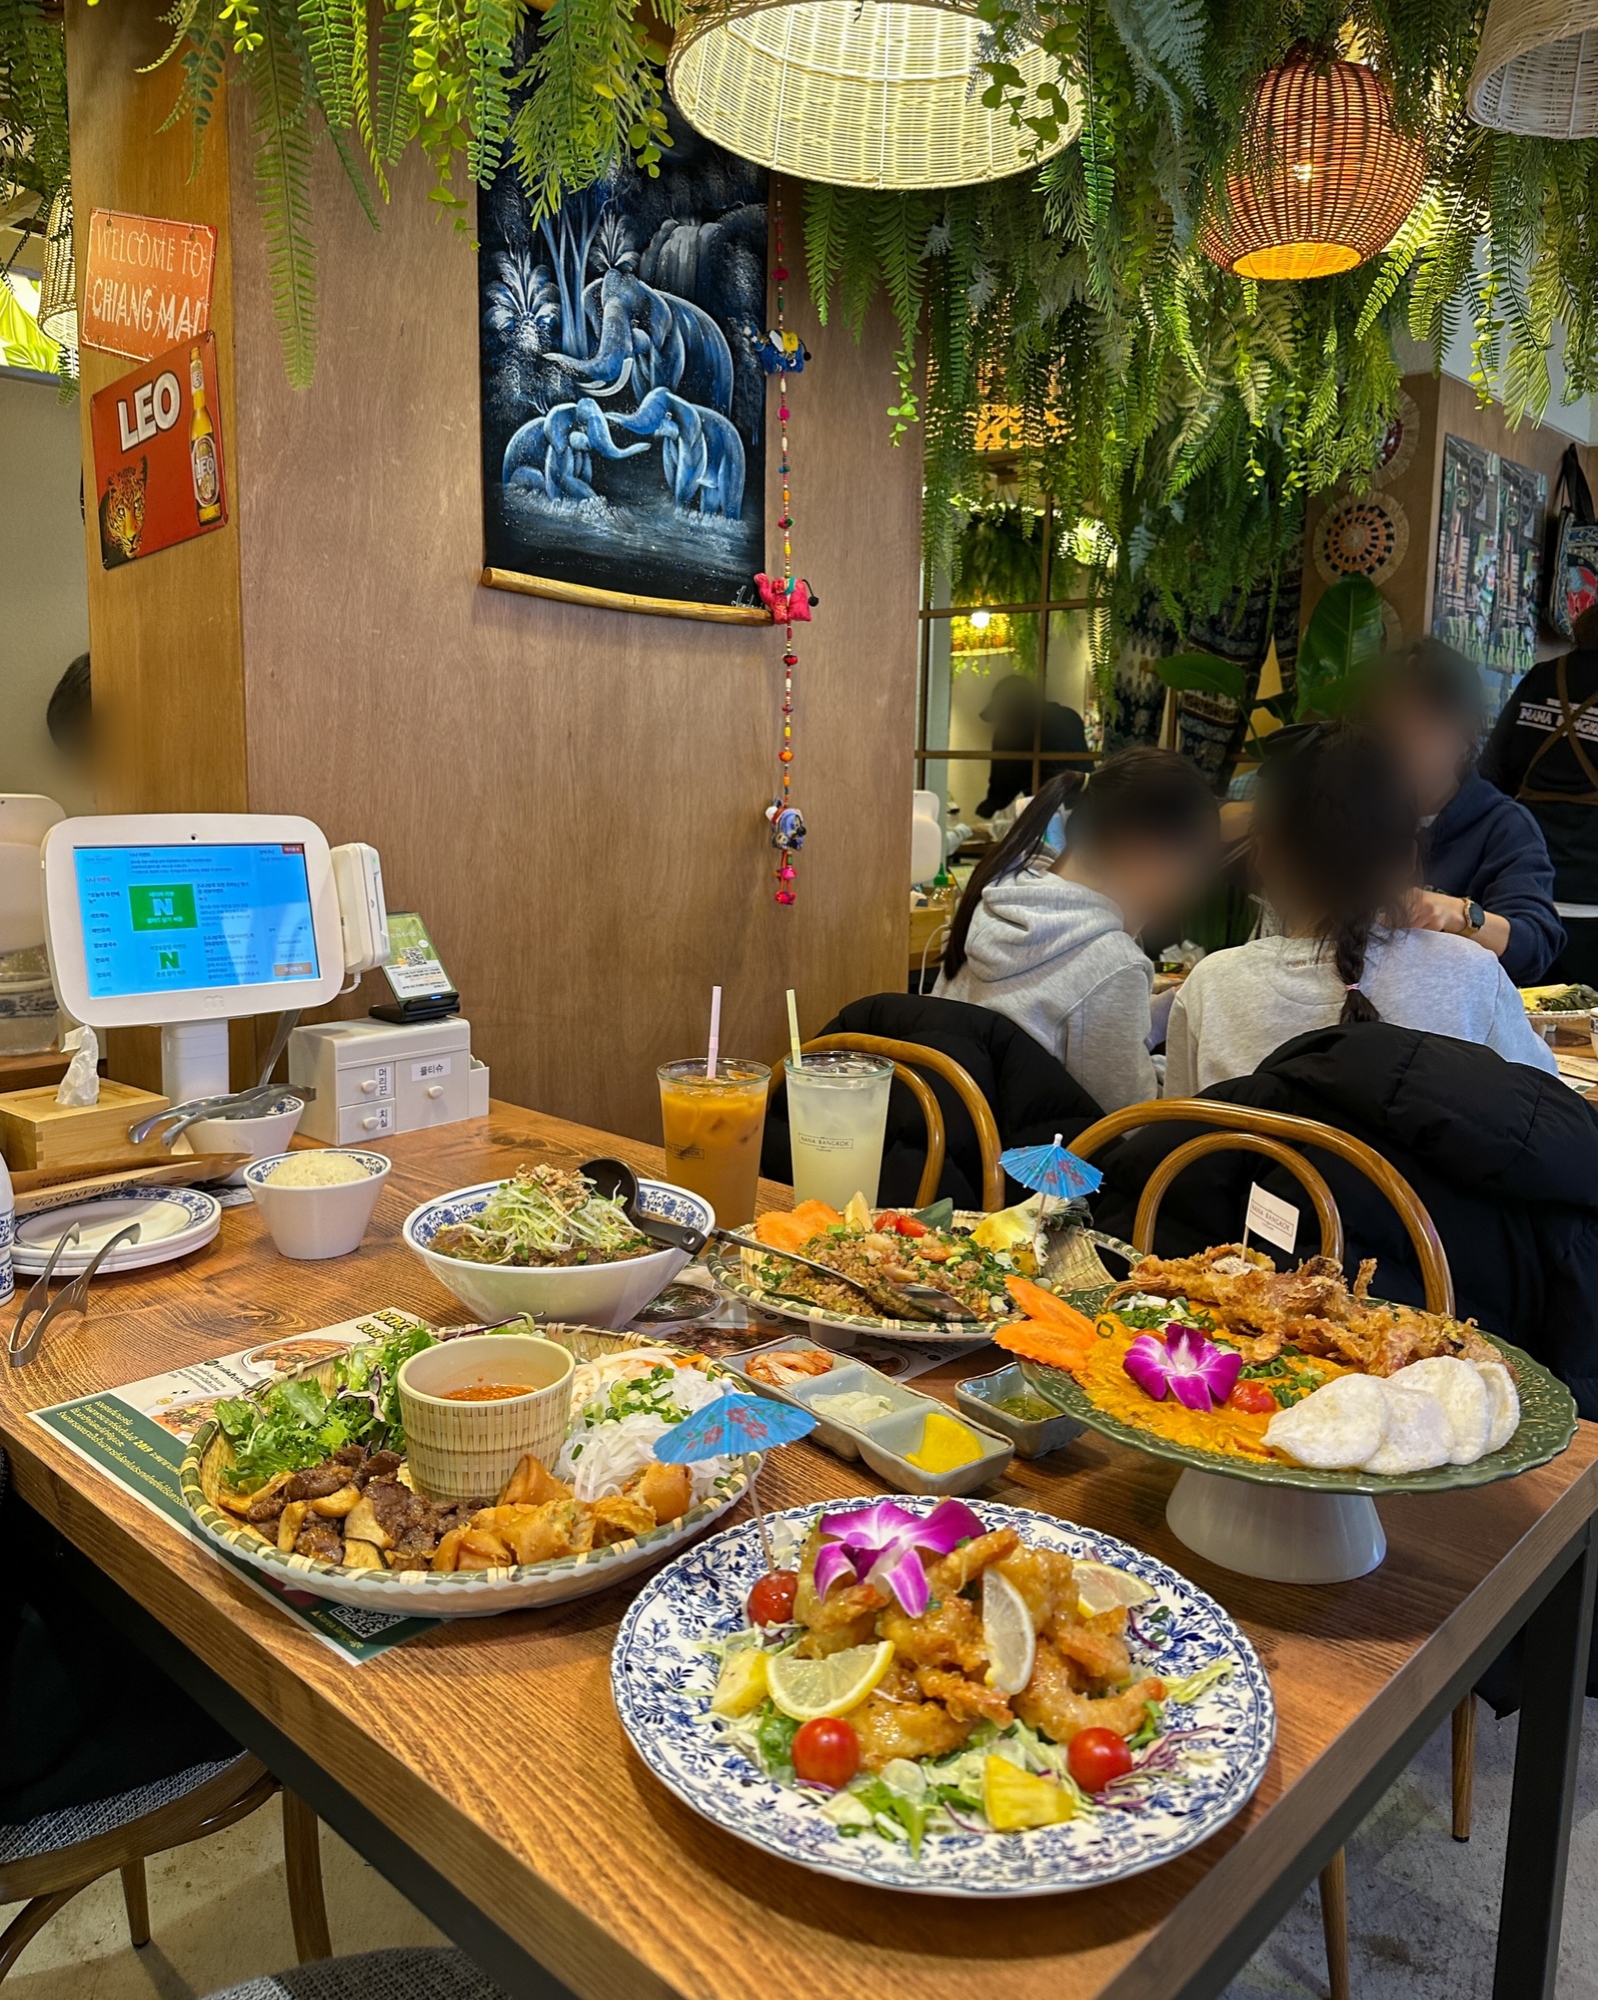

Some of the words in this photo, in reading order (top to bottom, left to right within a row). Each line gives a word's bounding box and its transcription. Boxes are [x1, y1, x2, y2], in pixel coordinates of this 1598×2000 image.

[97, 225, 175, 272] WELCOME
[181, 239, 204, 278] TO
[92, 278, 153, 332] CHIANG
[117, 371, 181, 452] LEO
[195, 456, 215, 480] LEO
[1519, 707, 1553, 726] NANA
[152, 897, 174, 916] N
[159, 951, 180, 970] N
[420, 1064, 444, 1077] 물티슈
[379, 1108, 388, 1128] 치실
[818, 1139, 850, 1147] BANGKOK
[1265, 1211, 1291, 1231] BANGKOK
[132, 1438, 154, 1454] 2019
[319, 1611, 336, 1628] Korea
[335, 1622, 365, 1650] language
